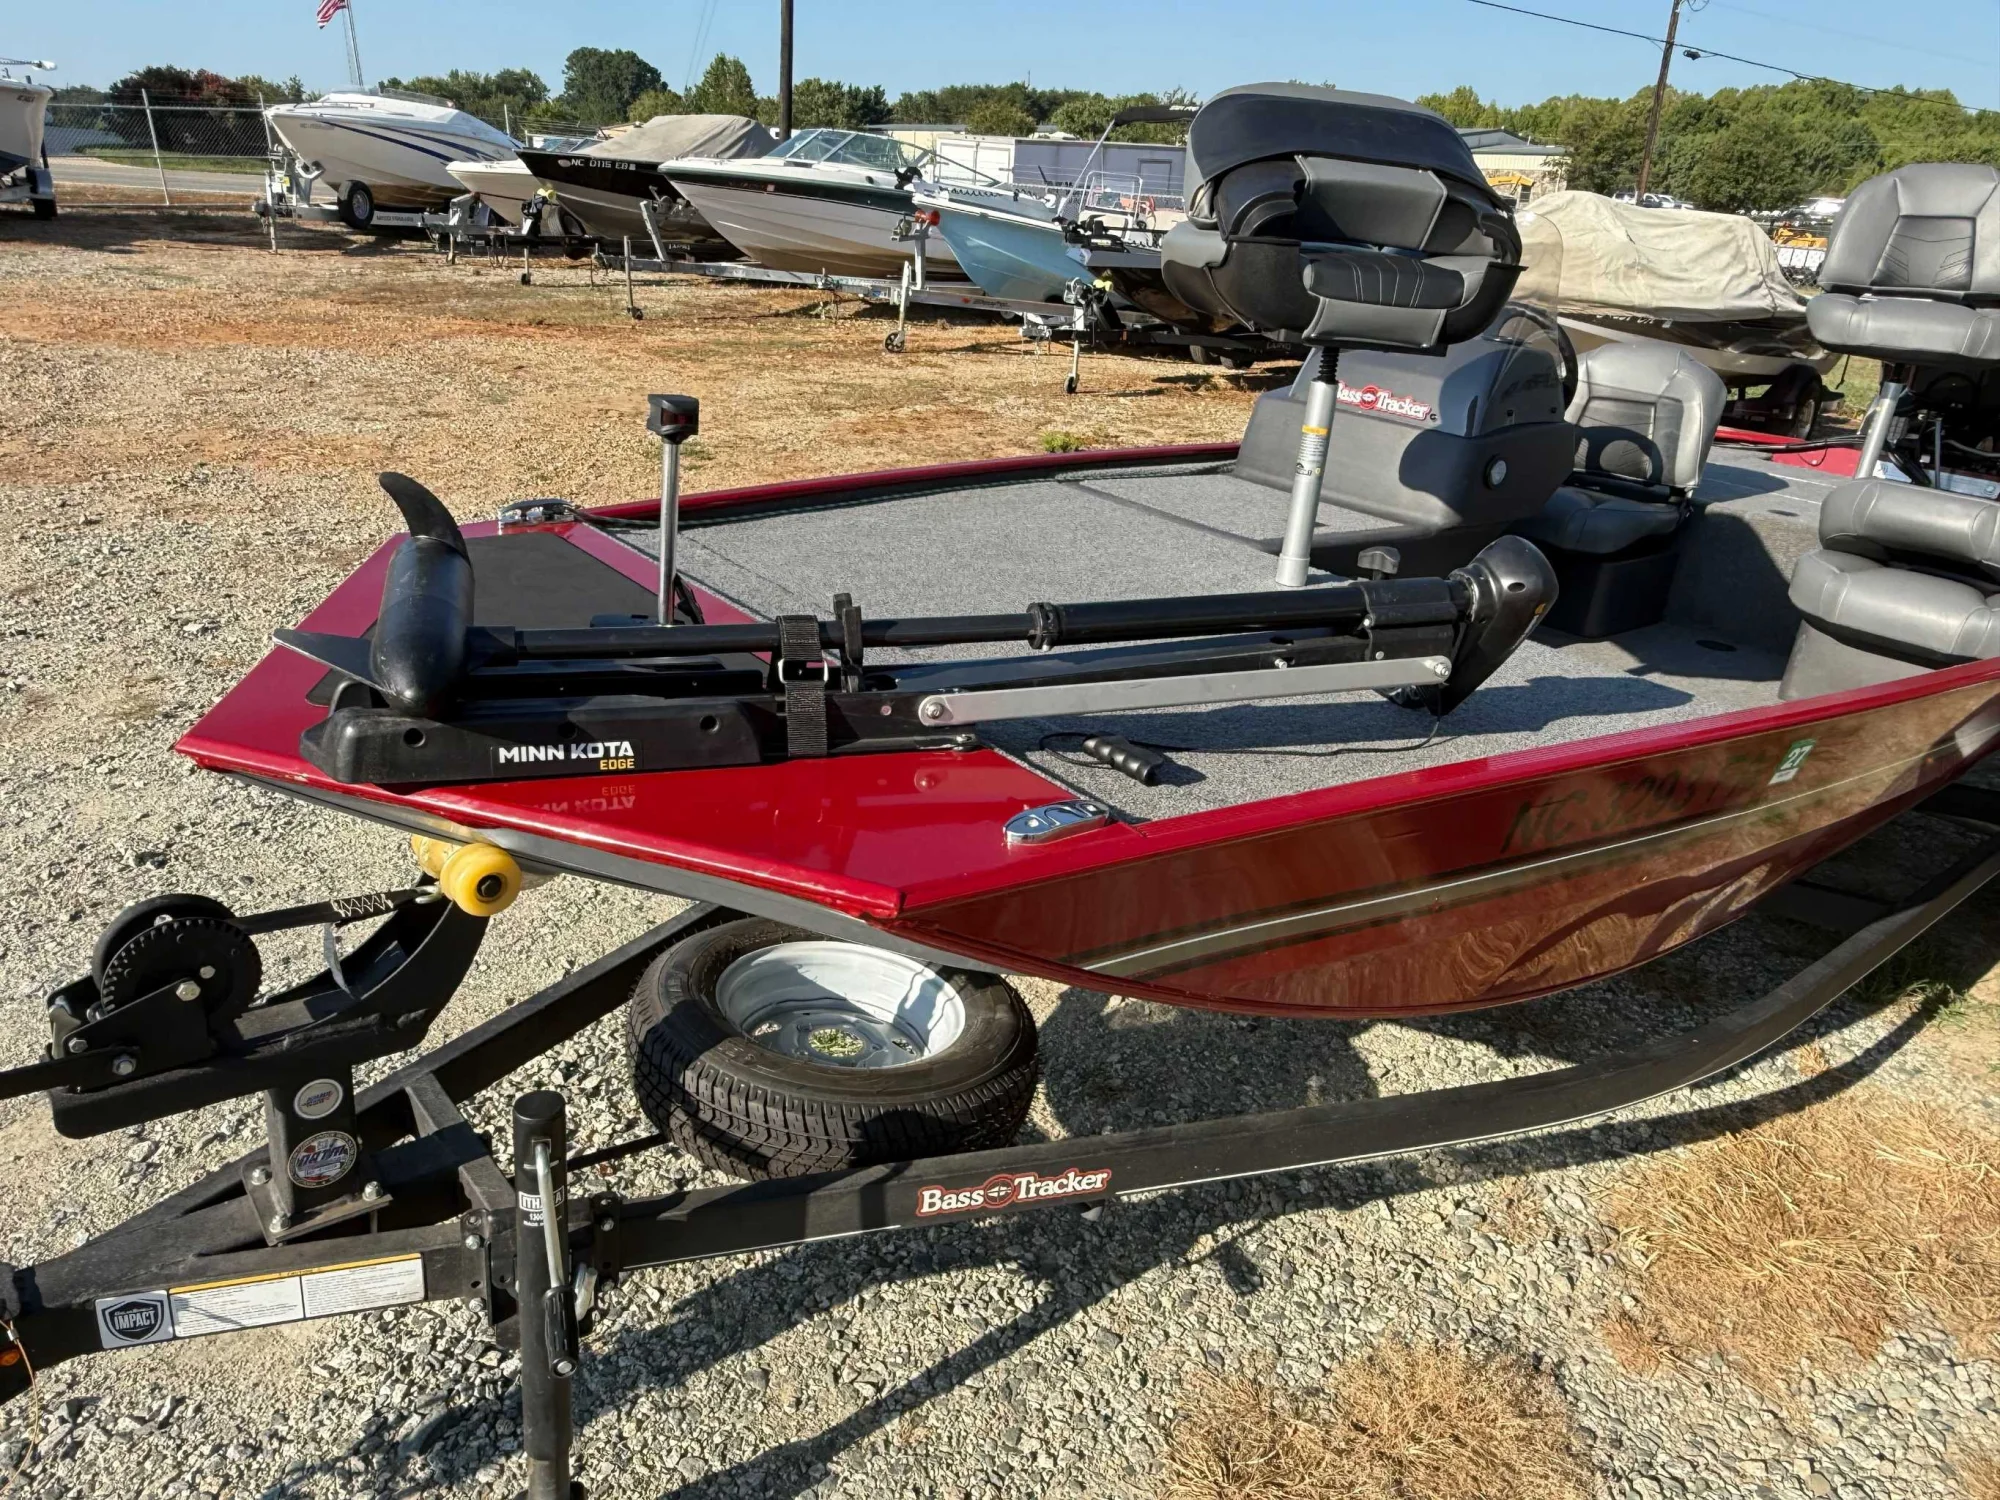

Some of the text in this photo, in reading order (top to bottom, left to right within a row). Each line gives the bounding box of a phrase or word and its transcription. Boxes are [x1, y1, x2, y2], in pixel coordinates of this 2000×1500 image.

[571, 158, 585, 167] NC
[1376, 390, 1430, 419] Tracker
[499, 740, 635, 764] MINN KOTA
[1780, 745, 1813, 770] 27
[600, 758, 636, 770] EDGE
[522, 1190, 563, 1209] ITHA
[920, 1171, 1108, 1213] Bass Tracker
[114, 1310, 156, 1331] IMPACT
